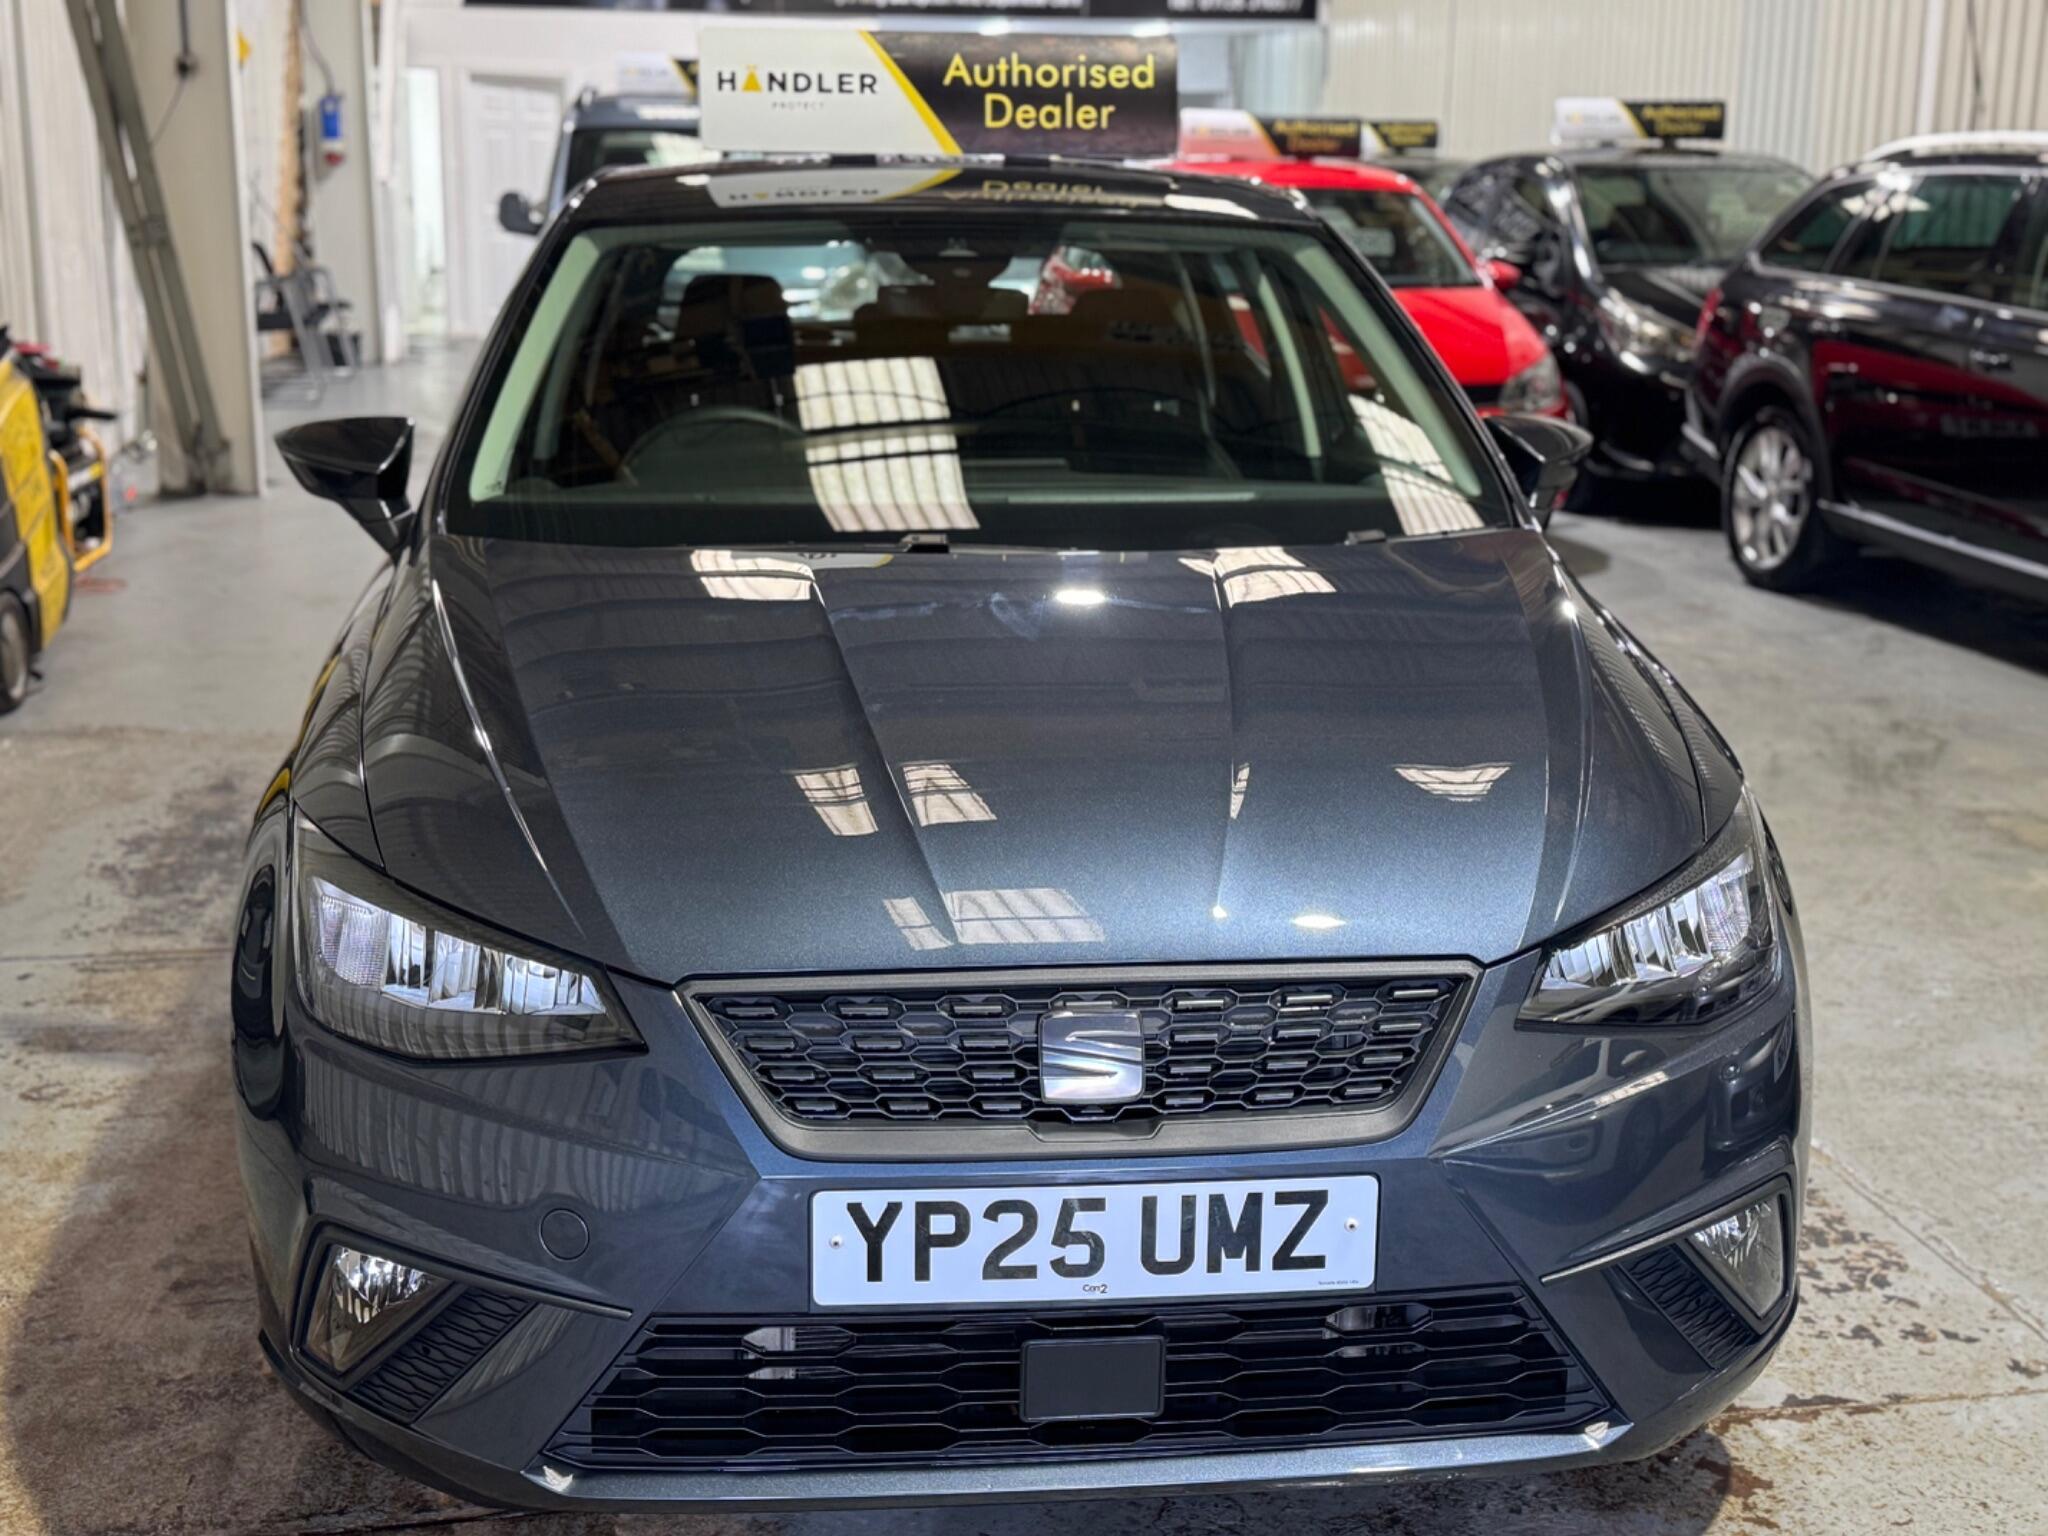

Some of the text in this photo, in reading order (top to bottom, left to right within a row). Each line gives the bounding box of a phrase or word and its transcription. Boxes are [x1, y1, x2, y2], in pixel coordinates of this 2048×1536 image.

[942, 52, 1155, 89] Authorised
[984, 92, 1116, 130] Dealer
[846, 1190, 1329, 1282] YP25 UMZ
